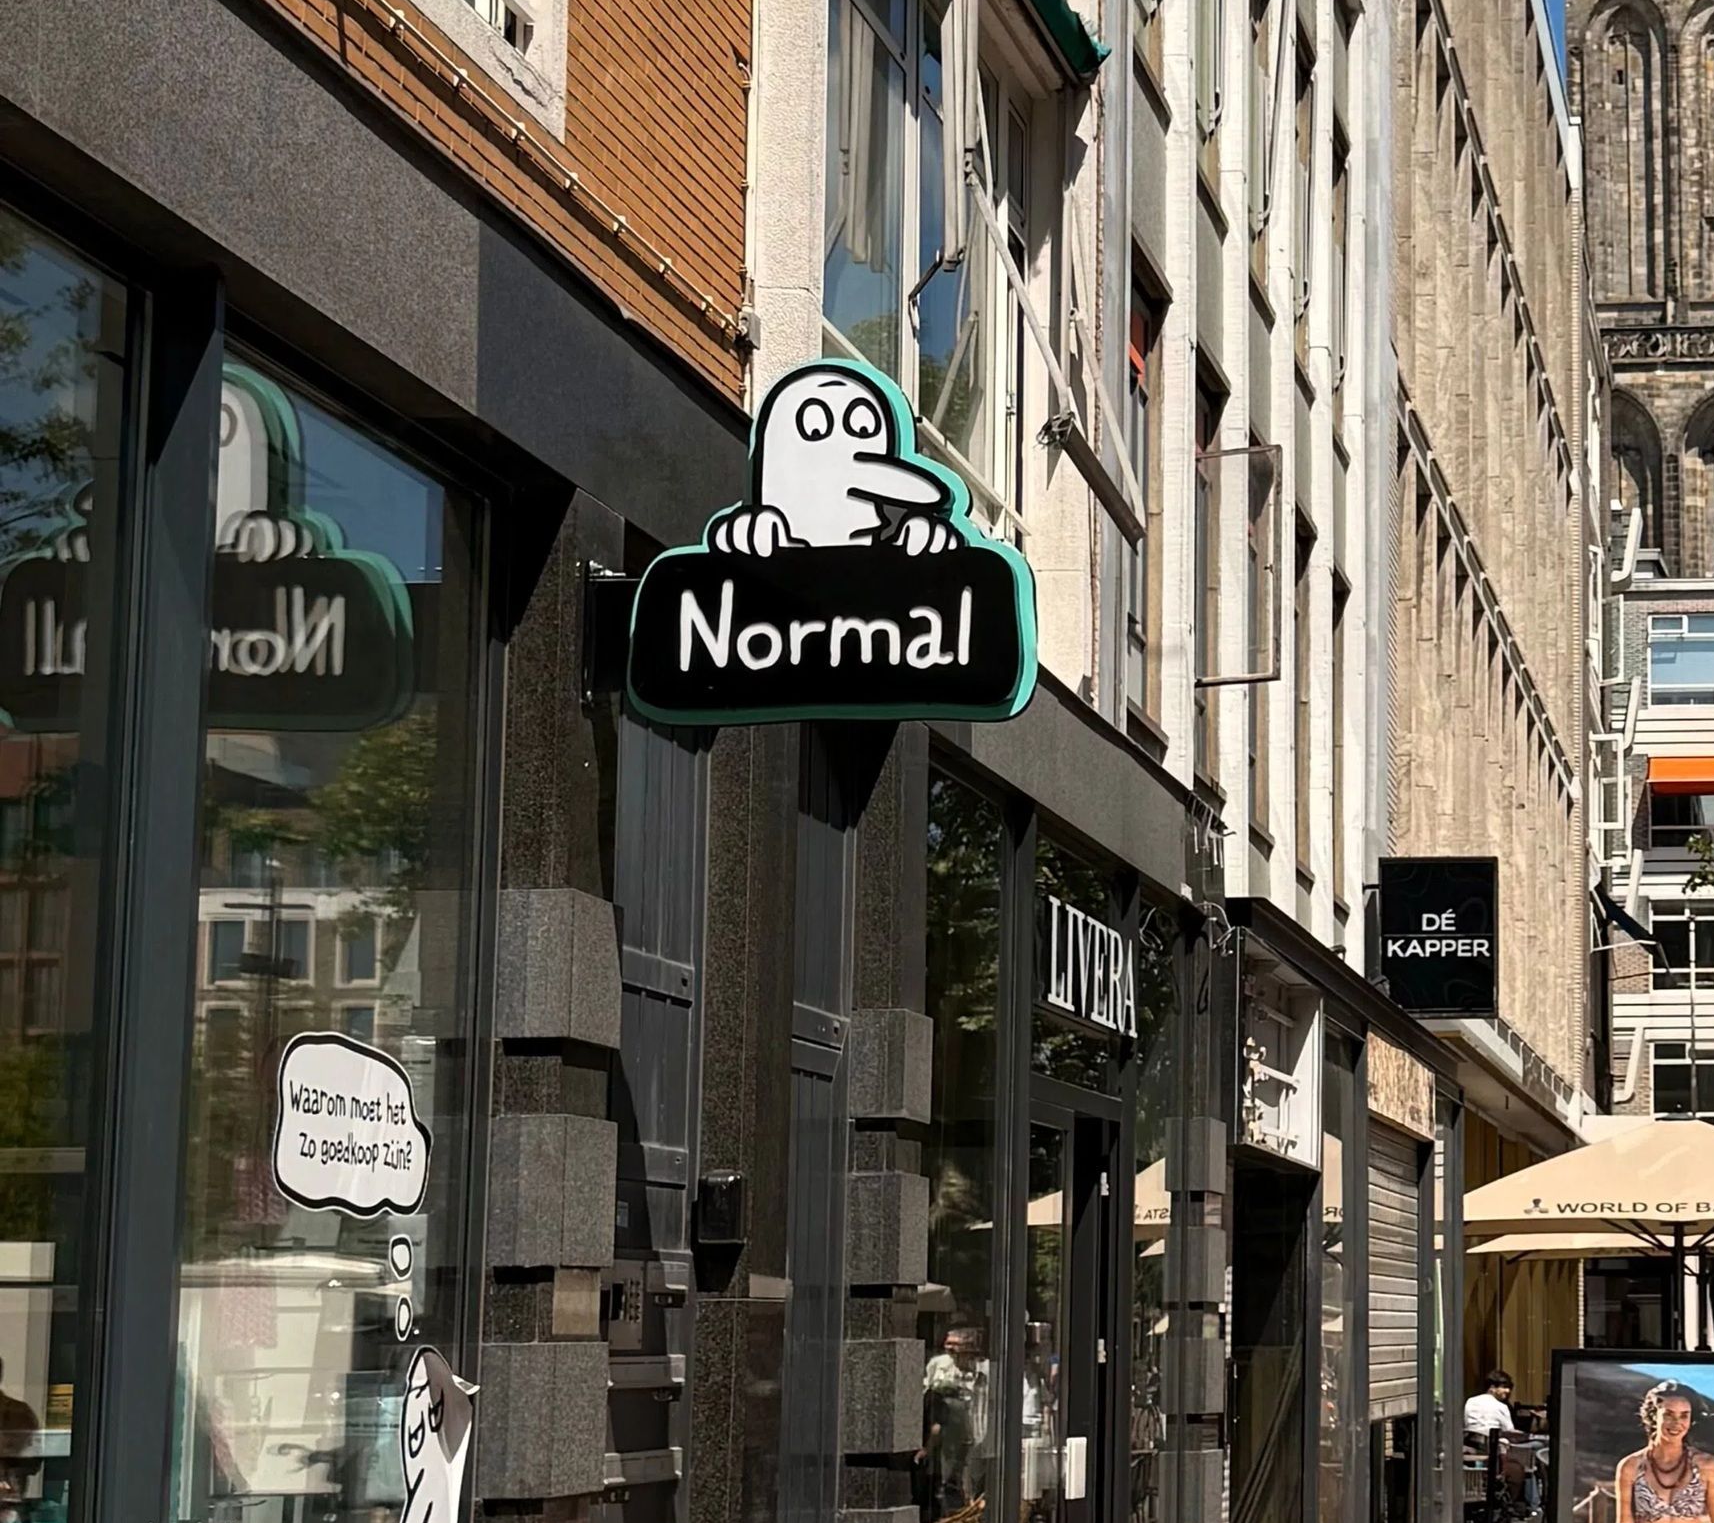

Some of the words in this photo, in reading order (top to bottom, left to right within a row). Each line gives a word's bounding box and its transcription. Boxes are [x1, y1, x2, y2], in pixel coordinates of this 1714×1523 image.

[679, 579, 972, 672] Normal
[1421, 908, 1456, 931] DÉ
[1047, 894, 1138, 1038] LIVERA
[1387, 939, 1491, 957] KAPPER
[289, 1079, 346, 1118] Waarom
[350, 1096, 382, 1123] moet
[386, 1092, 406, 1125] het
[321, 1131, 379, 1173] goedkoop
[1556, 1201, 1648, 1214] WORLD
[1655, 1201, 1689, 1214] OF
